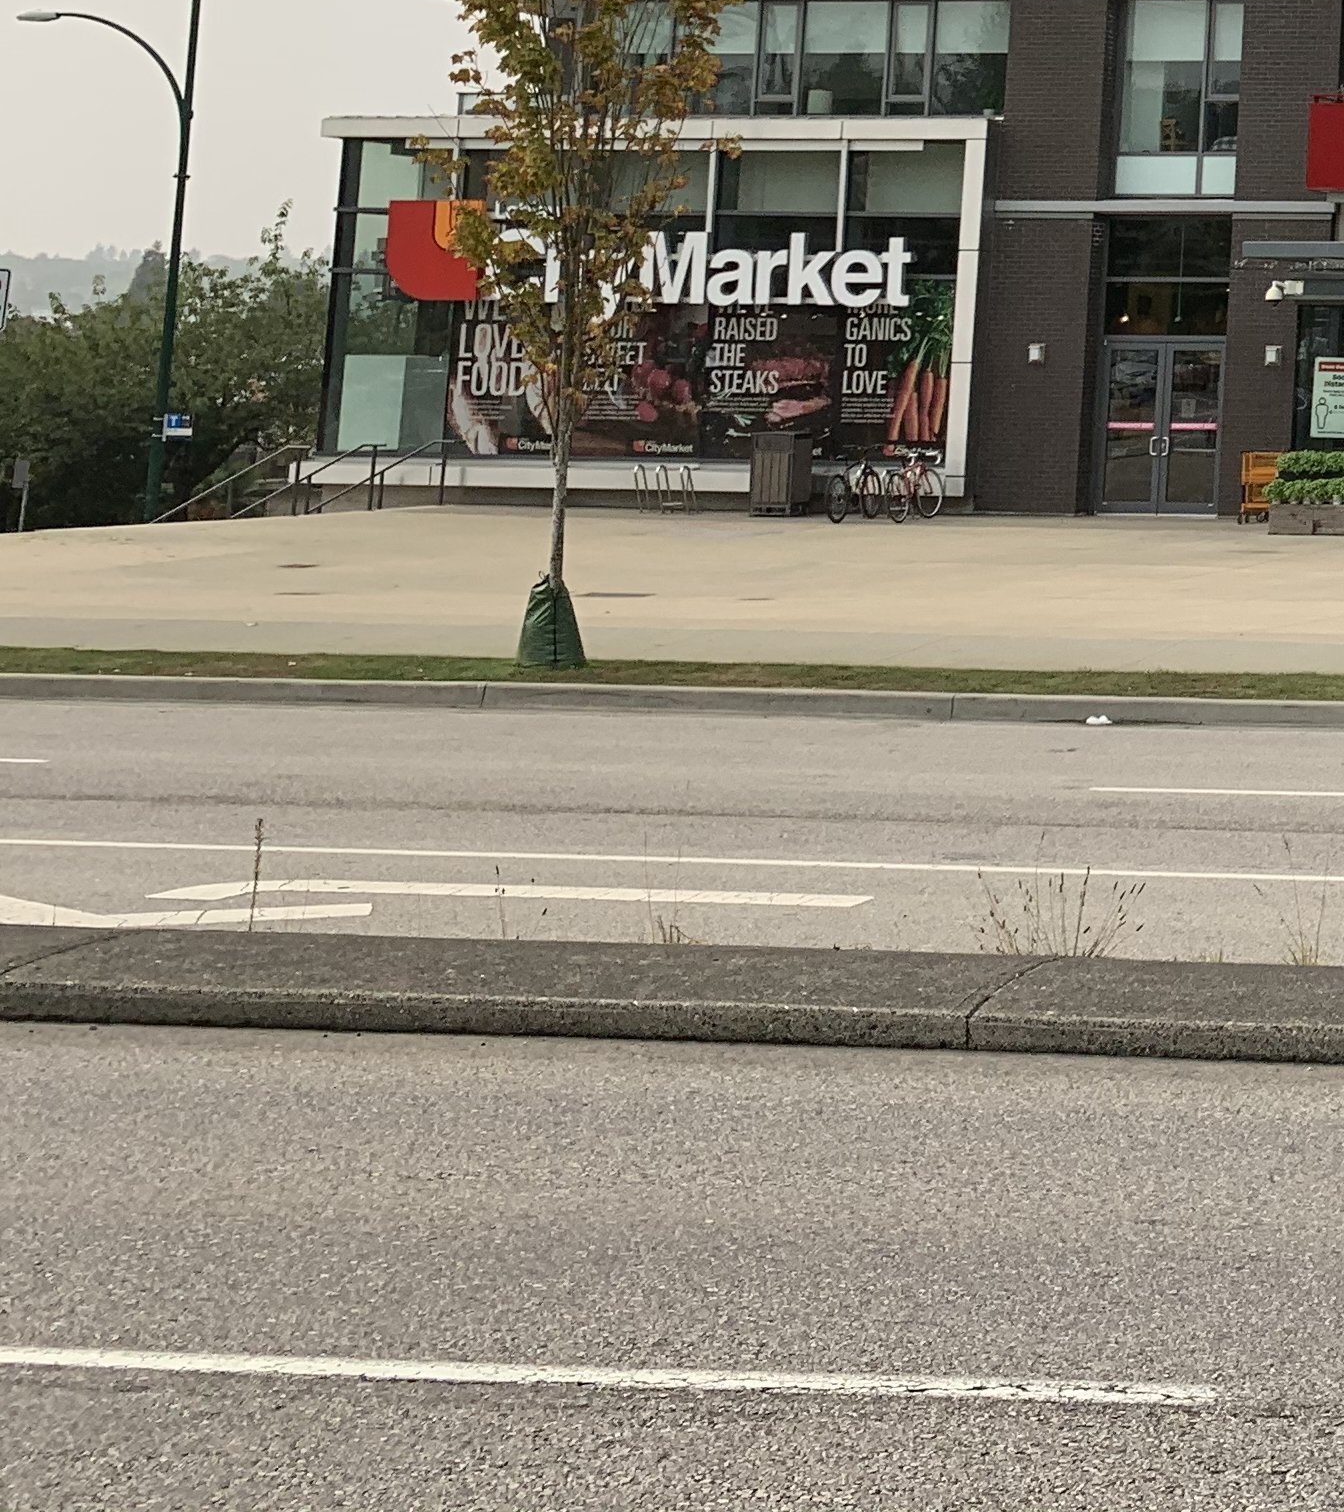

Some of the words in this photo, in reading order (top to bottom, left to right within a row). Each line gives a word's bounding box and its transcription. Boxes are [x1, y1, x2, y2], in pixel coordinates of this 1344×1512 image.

[483, 226, 912, 324] CiyMarket
[713, 316, 779, 341] RAISED
[845, 316, 913, 342] GANICS
[584, 341, 648, 365] SEET
[713, 343, 746, 367] THE
[843, 343, 868, 368] TO
[455, 360, 526, 397] FOOD
[709, 370, 781, 394] STEAKS
[841, 370, 889, 394] LOVE
